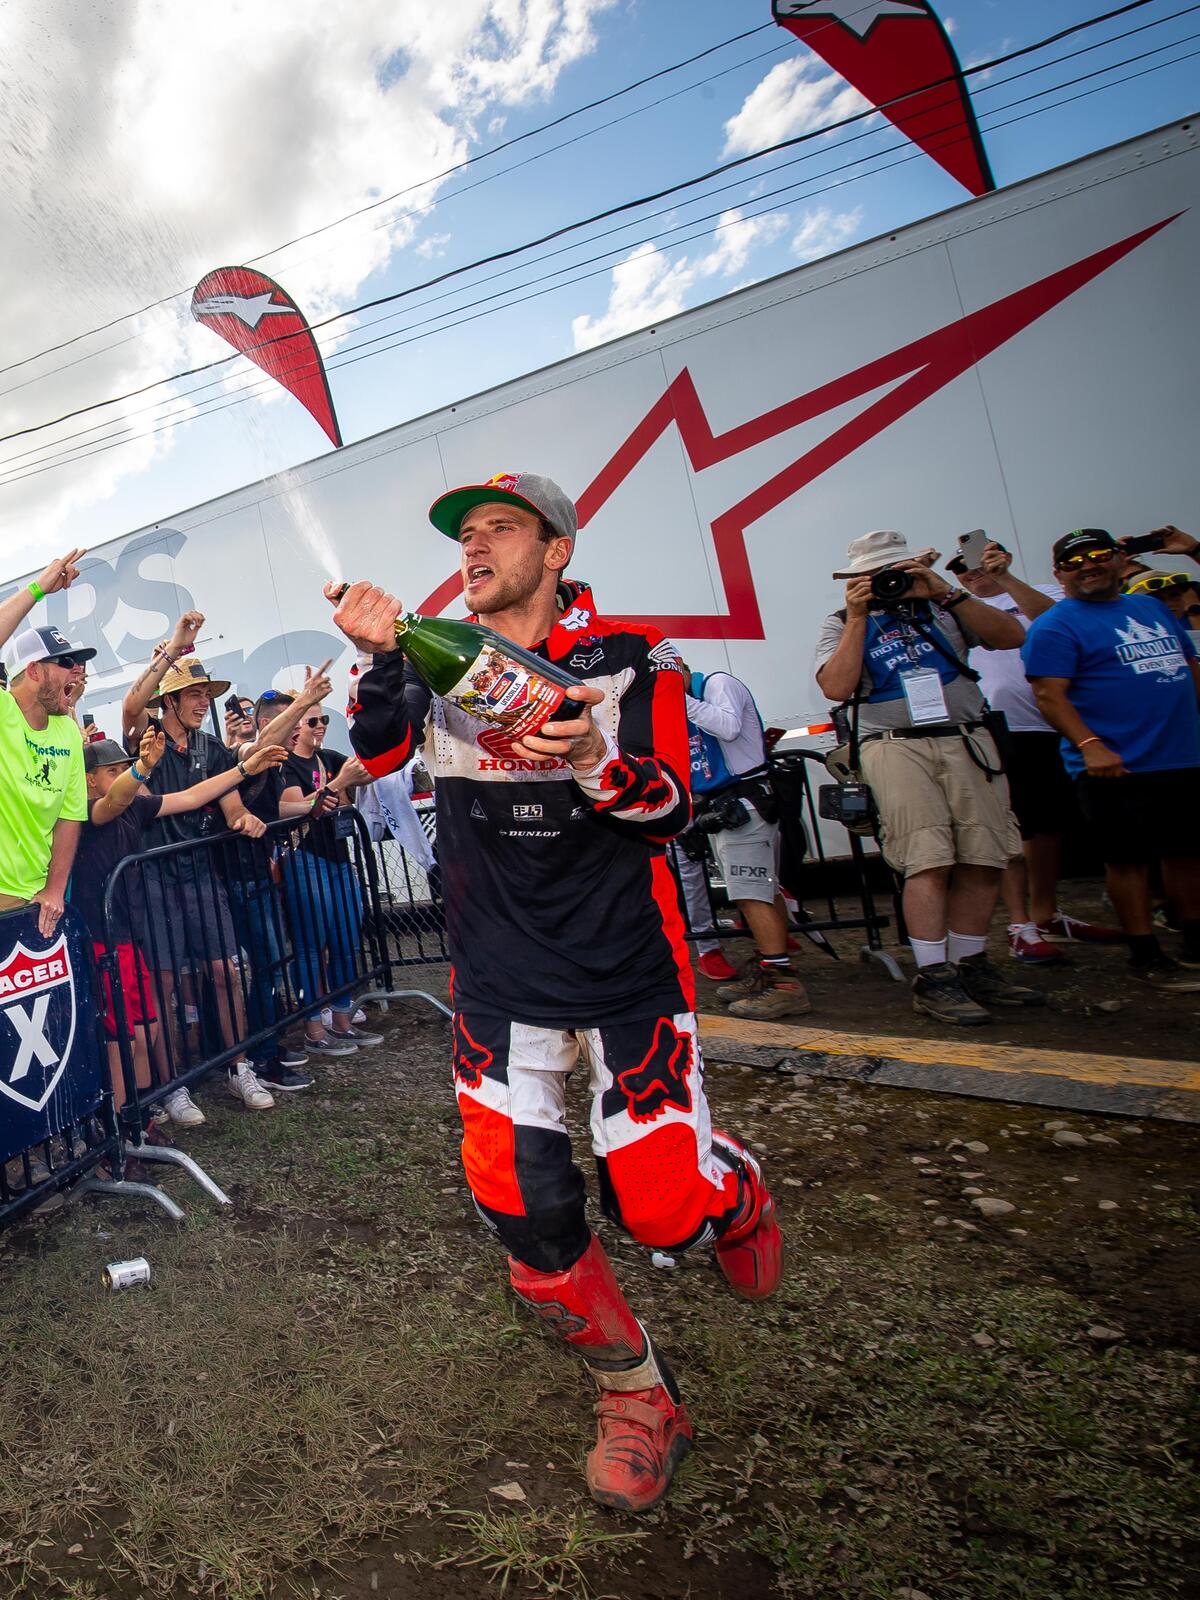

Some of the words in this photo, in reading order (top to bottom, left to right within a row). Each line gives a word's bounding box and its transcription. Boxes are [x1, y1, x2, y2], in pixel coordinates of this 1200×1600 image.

[1120, 637, 1179, 661] UNADILL
[508, 830, 561, 838] DUNLOP
[738, 865, 768, 879] FXR
[3, 993, 60, 1083] X
